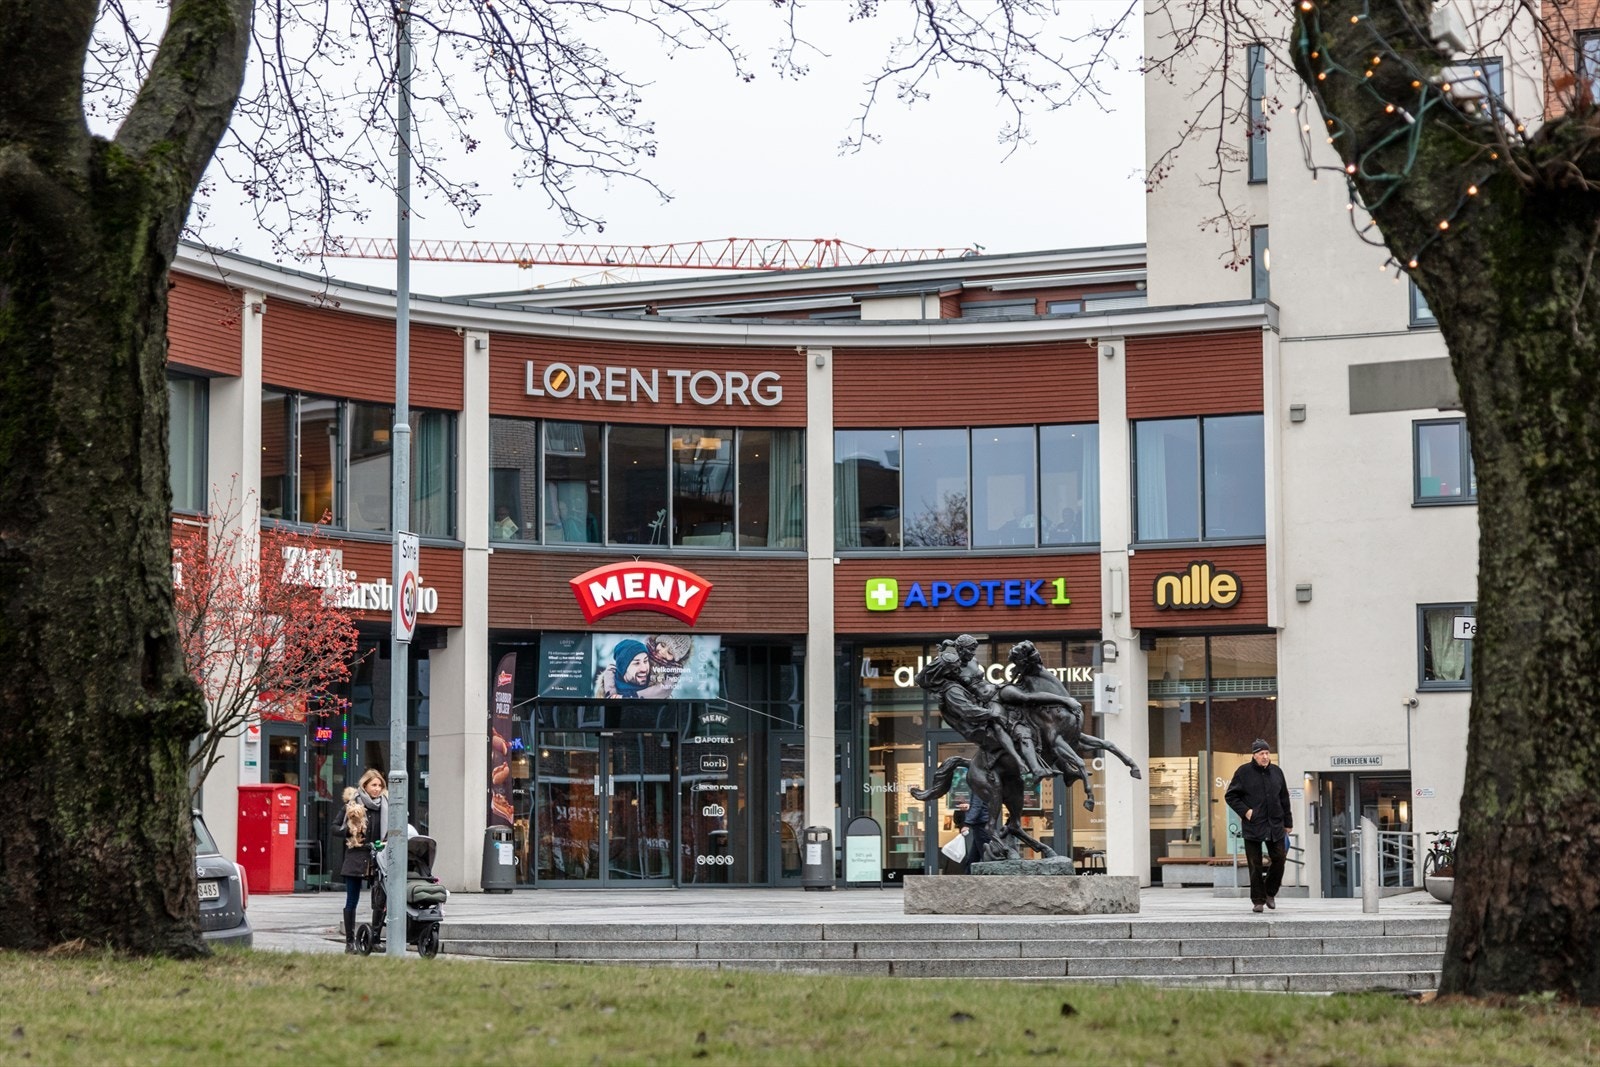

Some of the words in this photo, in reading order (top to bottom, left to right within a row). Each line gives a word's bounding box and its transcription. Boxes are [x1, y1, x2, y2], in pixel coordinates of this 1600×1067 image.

[667, 369, 783, 406] TORG
[402, 539, 417, 561] Sone
[589, 572, 700, 608] MENY
[904, 580, 1047, 608] APOTEK
[1050, 577, 1071, 606] 1
[1156, 563, 1238, 606] nille
[405, 586, 414, 618] 30
[701, 714, 728, 725] MENY
[703, 758, 726, 767] norli
[1332, 757, 1367, 766] LØRENVEIEN
[1369, 757, 1380, 765] 44C
[703, 805, 725, 816] nille
[198, 884, 217, 897] 8485
